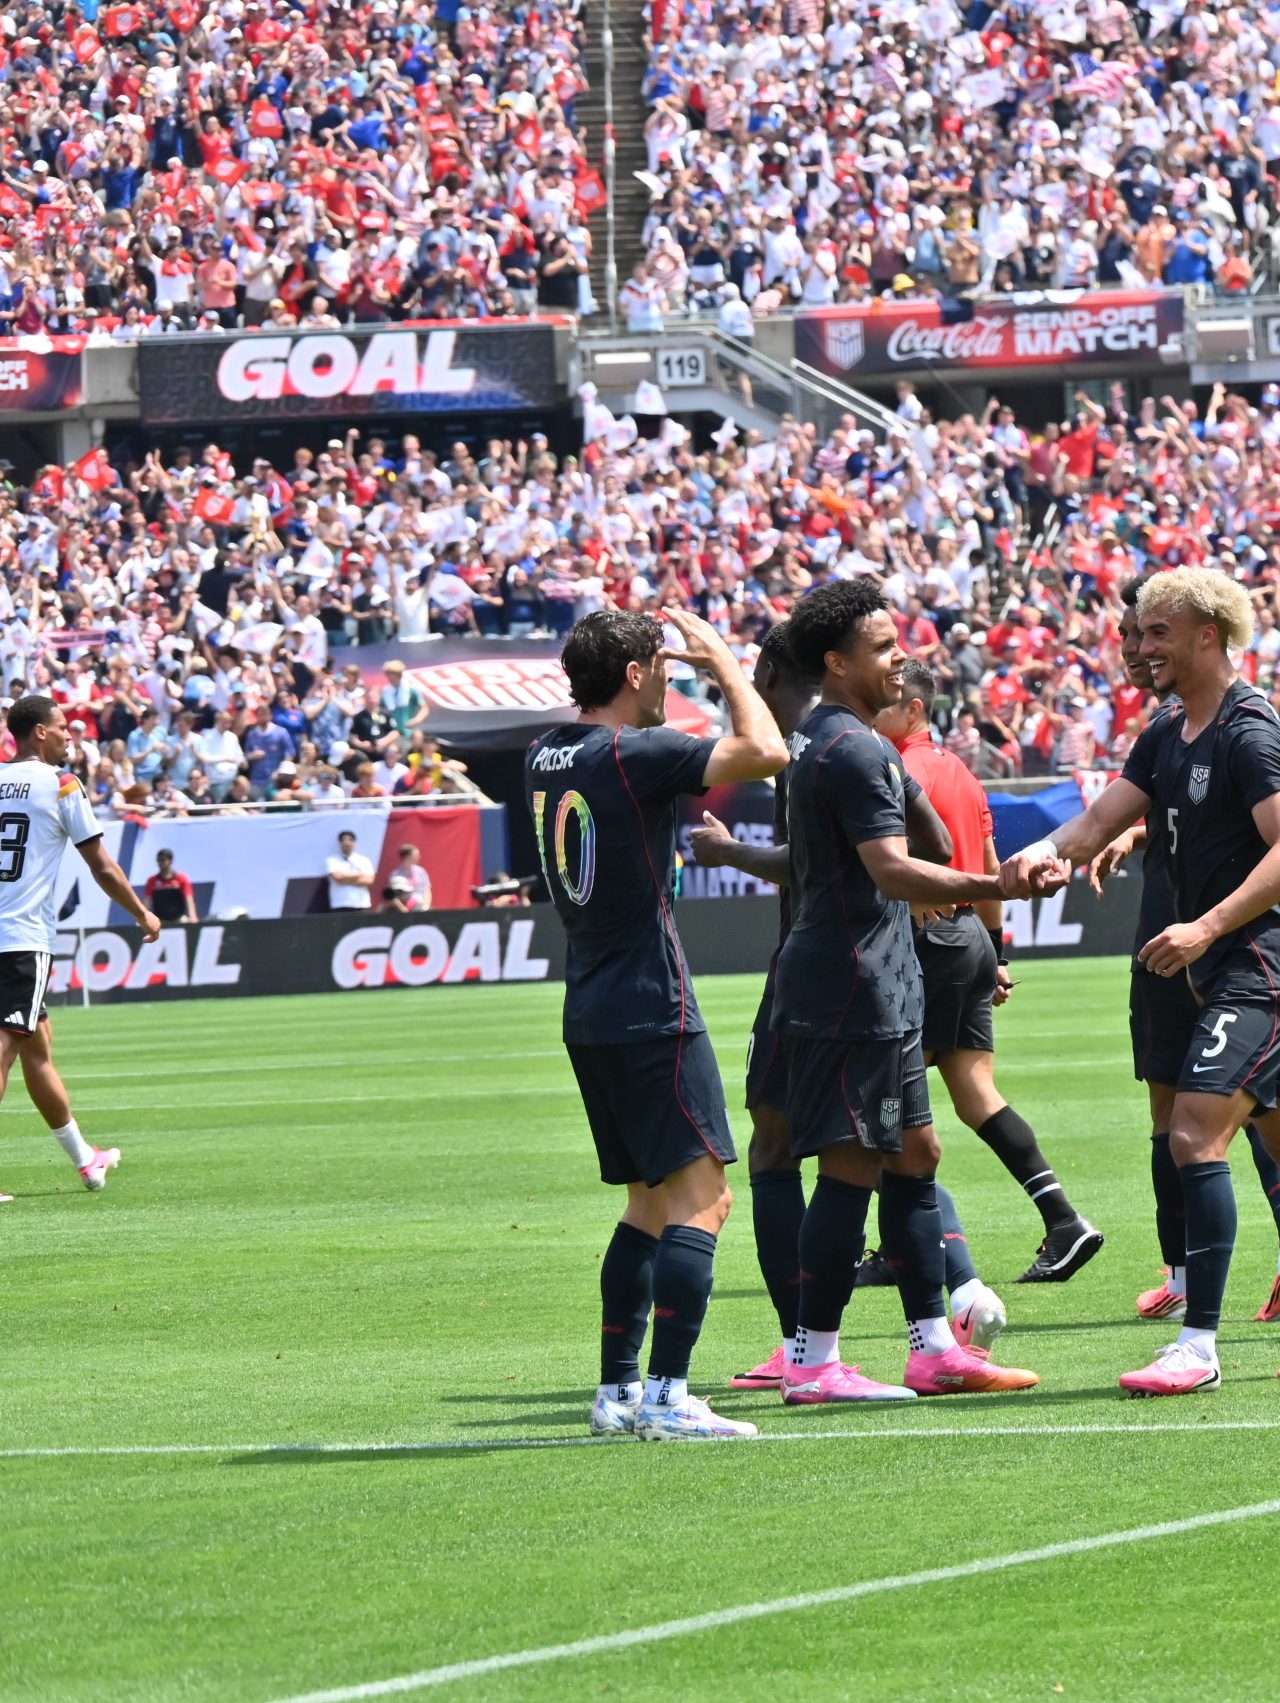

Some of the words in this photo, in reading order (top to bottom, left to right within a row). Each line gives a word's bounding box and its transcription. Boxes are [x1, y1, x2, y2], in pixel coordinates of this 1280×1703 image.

[1013, 305, 1157, 331] SEND-OFF
[1014, 325, 1158, 356] MATCH
[217, 331, 476, 402] GOAL
[664, 355, 699, 378] 119
[1192, 766, 1209, 783] USA
[0, 812, 31, 882] 3
[533, 789, 596, 906] 10
[1167, 807, 1179, 855] 5
[1002, 886, 1084, 948] AL
[332, 919, 550, 989] GOAL
[1201, 1013, 1238, 1058] 5
[882, 1100, 900, 1114] USA
